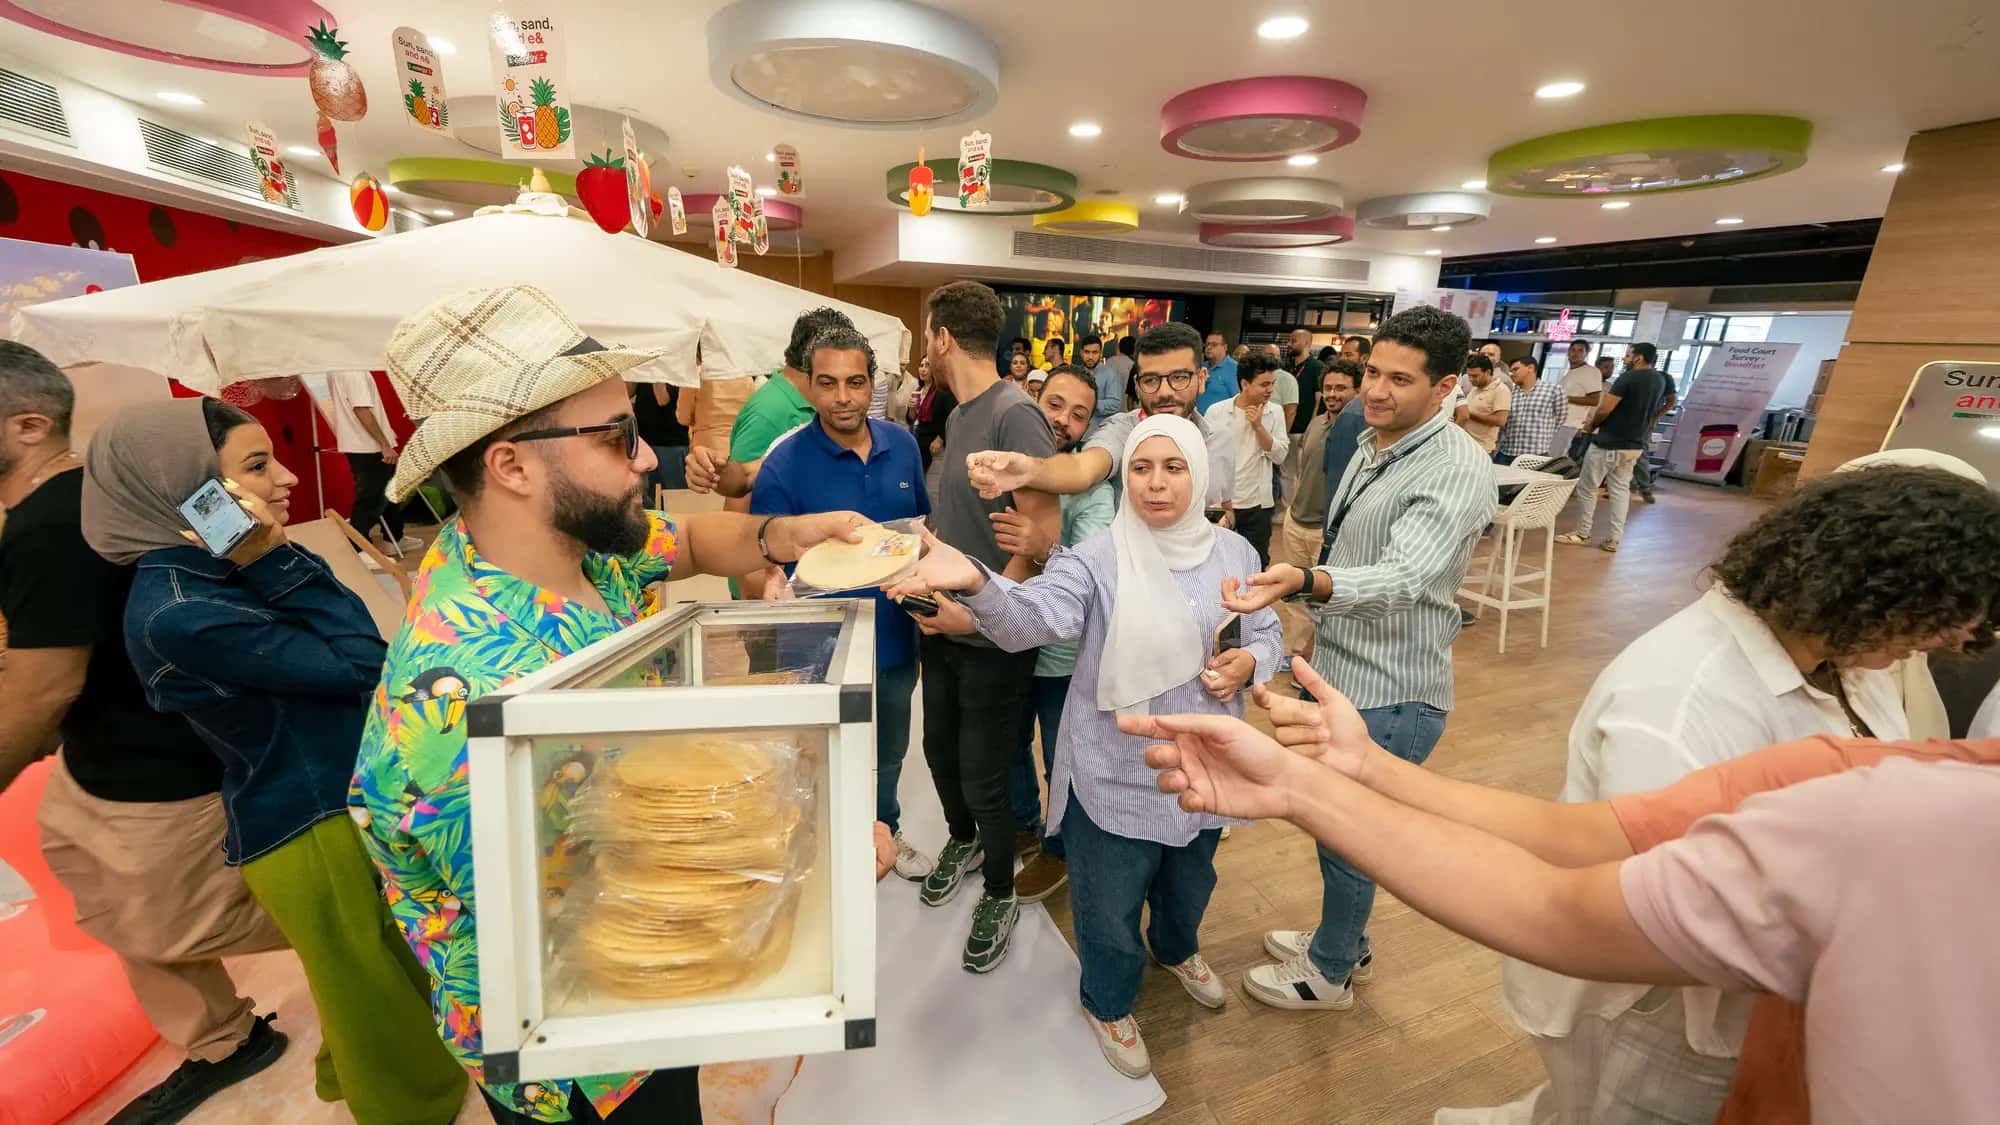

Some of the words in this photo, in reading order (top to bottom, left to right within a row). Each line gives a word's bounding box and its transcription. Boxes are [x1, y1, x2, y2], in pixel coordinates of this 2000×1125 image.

[521, 17, 554, 31] sand,
[527, 31, 545, 44] e&
[1728, 346, 1750, 355] Food
[1751, 347, 1776, 356] Court
[1729, 353, 1759, 361] Survey
[1956, 395, 2000, 409] an
